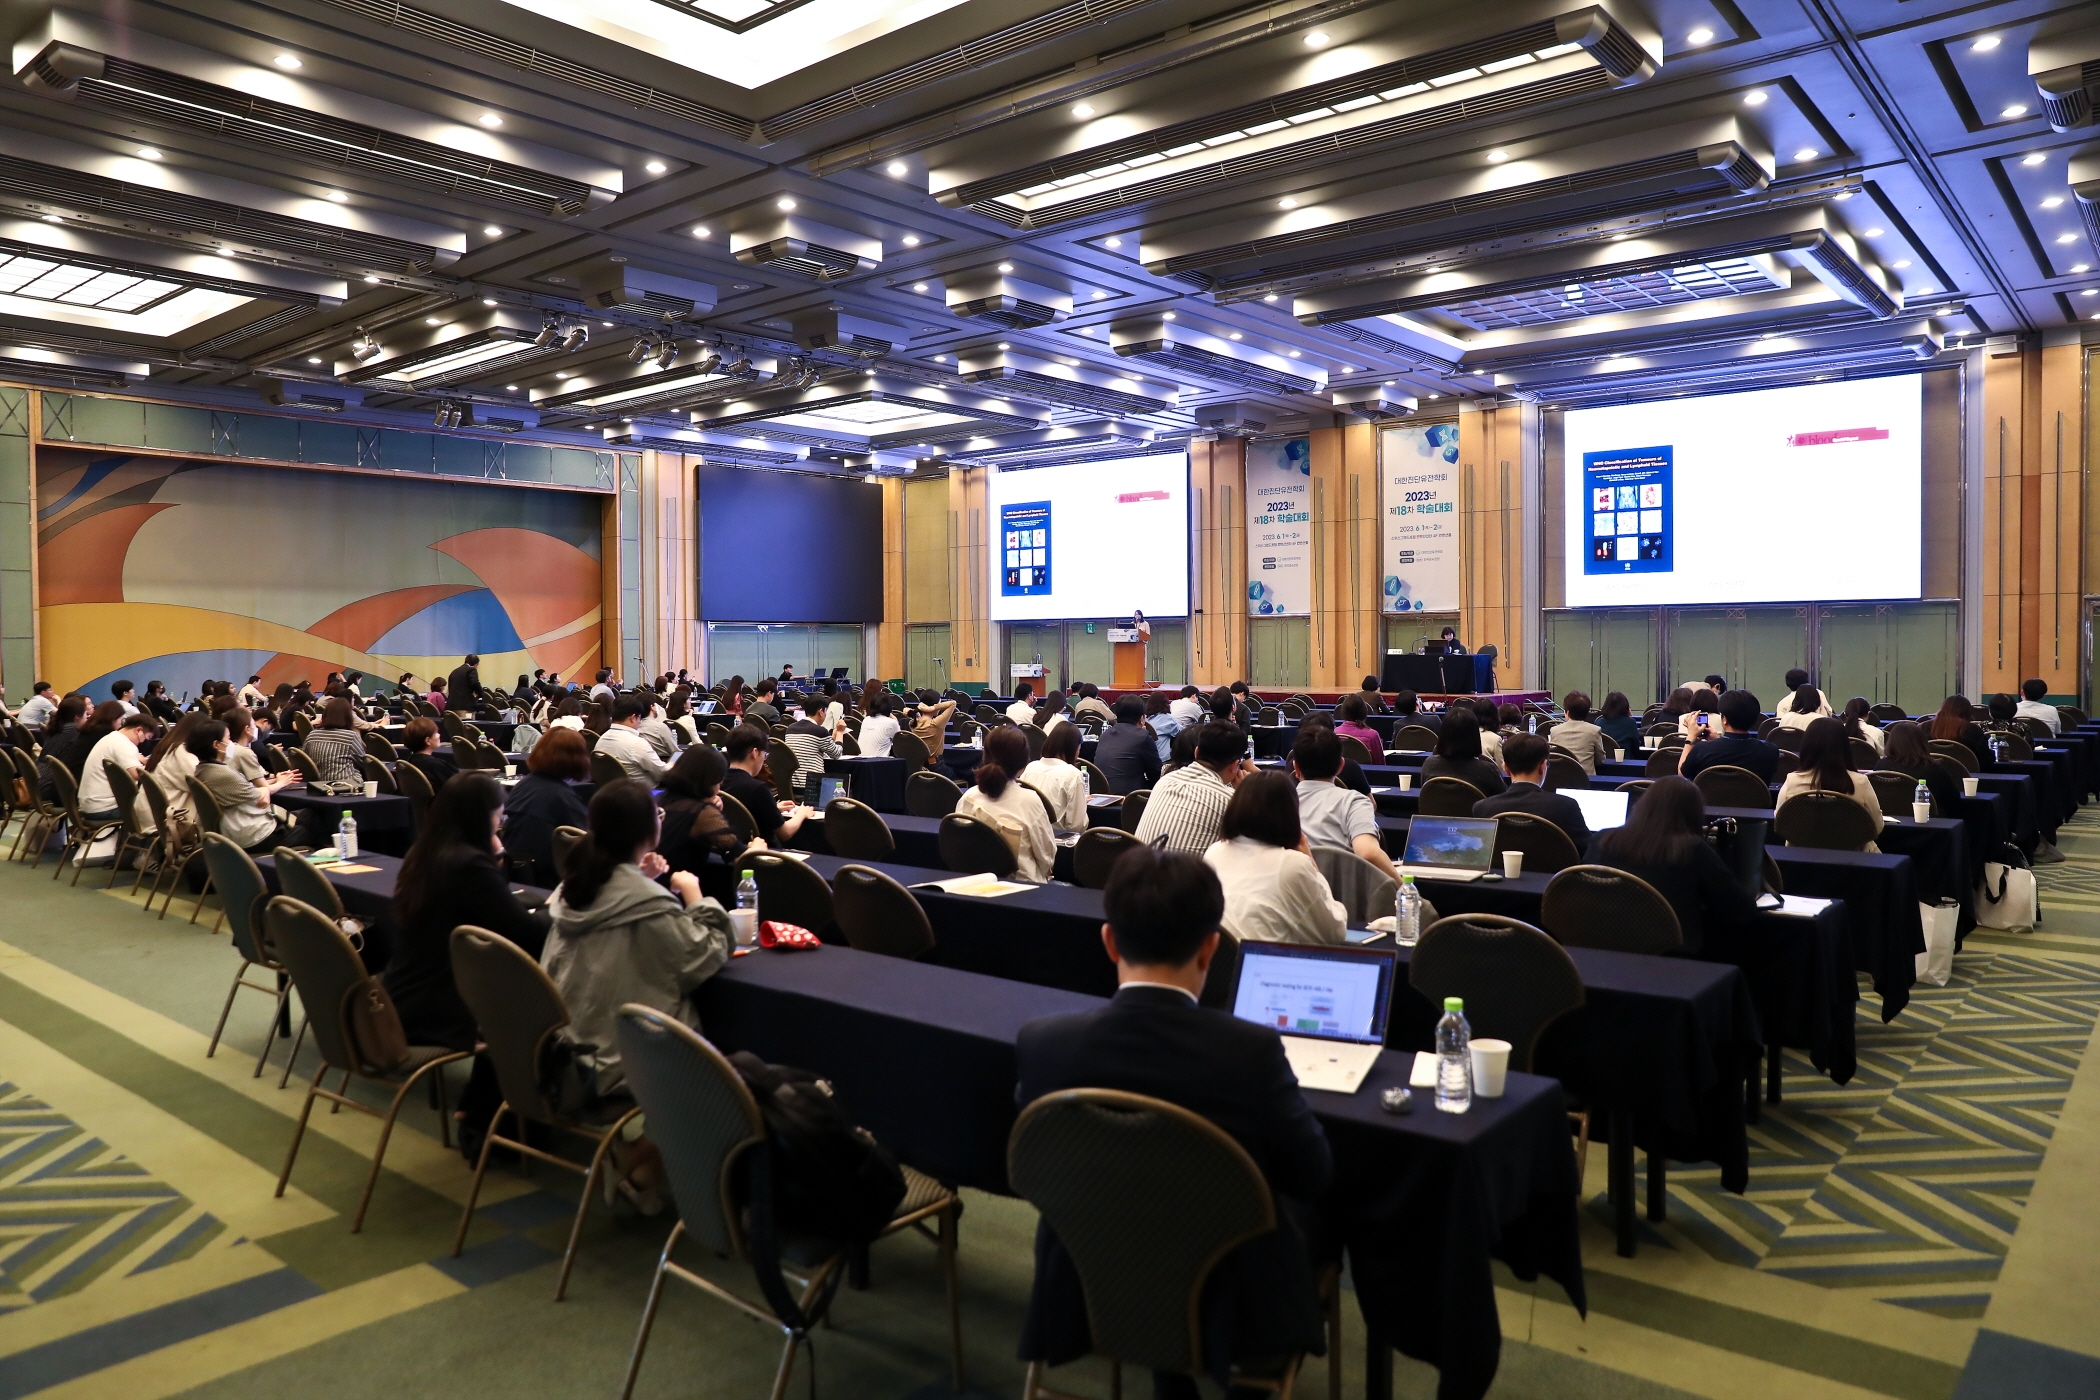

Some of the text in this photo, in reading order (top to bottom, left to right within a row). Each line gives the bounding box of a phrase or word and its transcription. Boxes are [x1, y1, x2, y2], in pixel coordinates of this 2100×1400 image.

[1394, 473, 1448, 485] 대한진단유전학회
[1257, 484, 1305, 496] 대한진단유전학회
[1404, 490, 1437, 502] 2023년
[1266, 501, 1295, 512] 2023년
[1389, 502, 1452, 516] 제18차 학술대회
[1253, 512, 1309, 525] 제18차 학술대회
